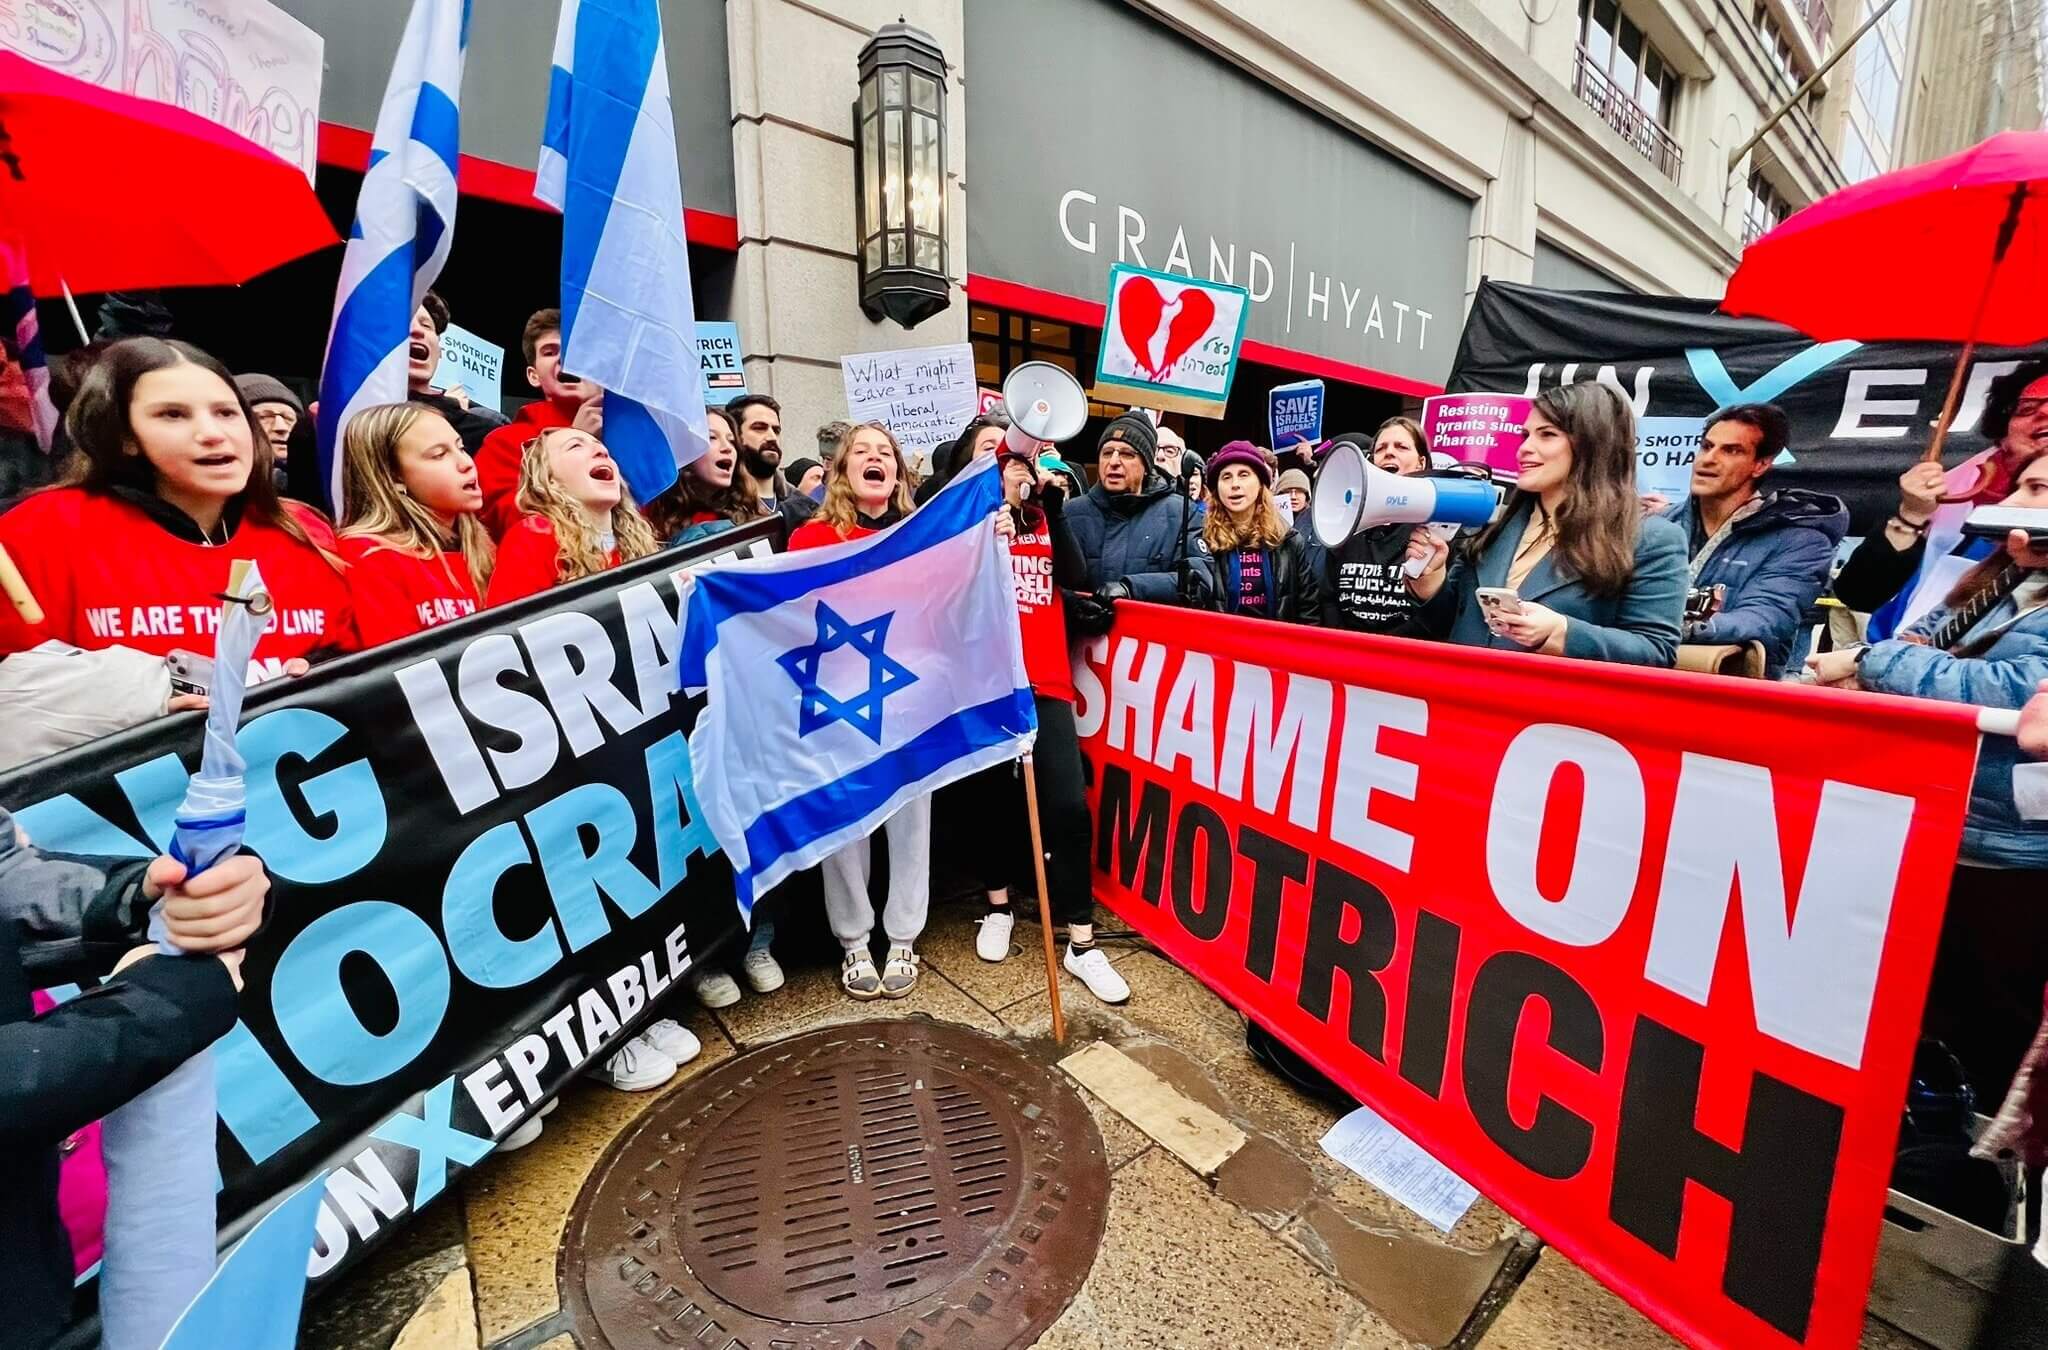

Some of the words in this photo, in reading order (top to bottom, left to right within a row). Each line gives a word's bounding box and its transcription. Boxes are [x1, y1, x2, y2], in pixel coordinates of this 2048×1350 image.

[1059, 189, 1275, 303] GRAND
[1307, 271, 1433, 351] HYATT
[445, 336, 498, 367] SMOTRICH
[696, 337, 733, 351] TRICH
[462, 354, 496, 381] HATE
[700, 353, 736, 369] ATE
[848, 359, 902, 383] What
[916, 358, 957, 384] might
[854, 386, 896, 402] save
[890, 402, 939, 418] liberal,
[1275, 395, 1319, 415] SAVE
[1439, 403, 1508, 420] Resisting
[1275, 411, 1317, 428] ISRAEL'S
[1435, 419, 1486, 434] tyrants
[1489, 419, 1523, 434] sinc
[1276, 421, 1317, 436] DEMOCRACY
[1433, 432, 1499, 448] Pharaoh.
[1665, 451, 1696, 467] HA
[86, 608, 124, 637] WE
[131, 606, 184, 635] ARE
[188, 606, 224, 635] TH
[283, 609, 325, 635] LINE
[1070, 634, 1429, 872] SHAME
[1486, 723, 1916, 1071] ON
[1086, 755, 1846, 1343] MOTRICH
